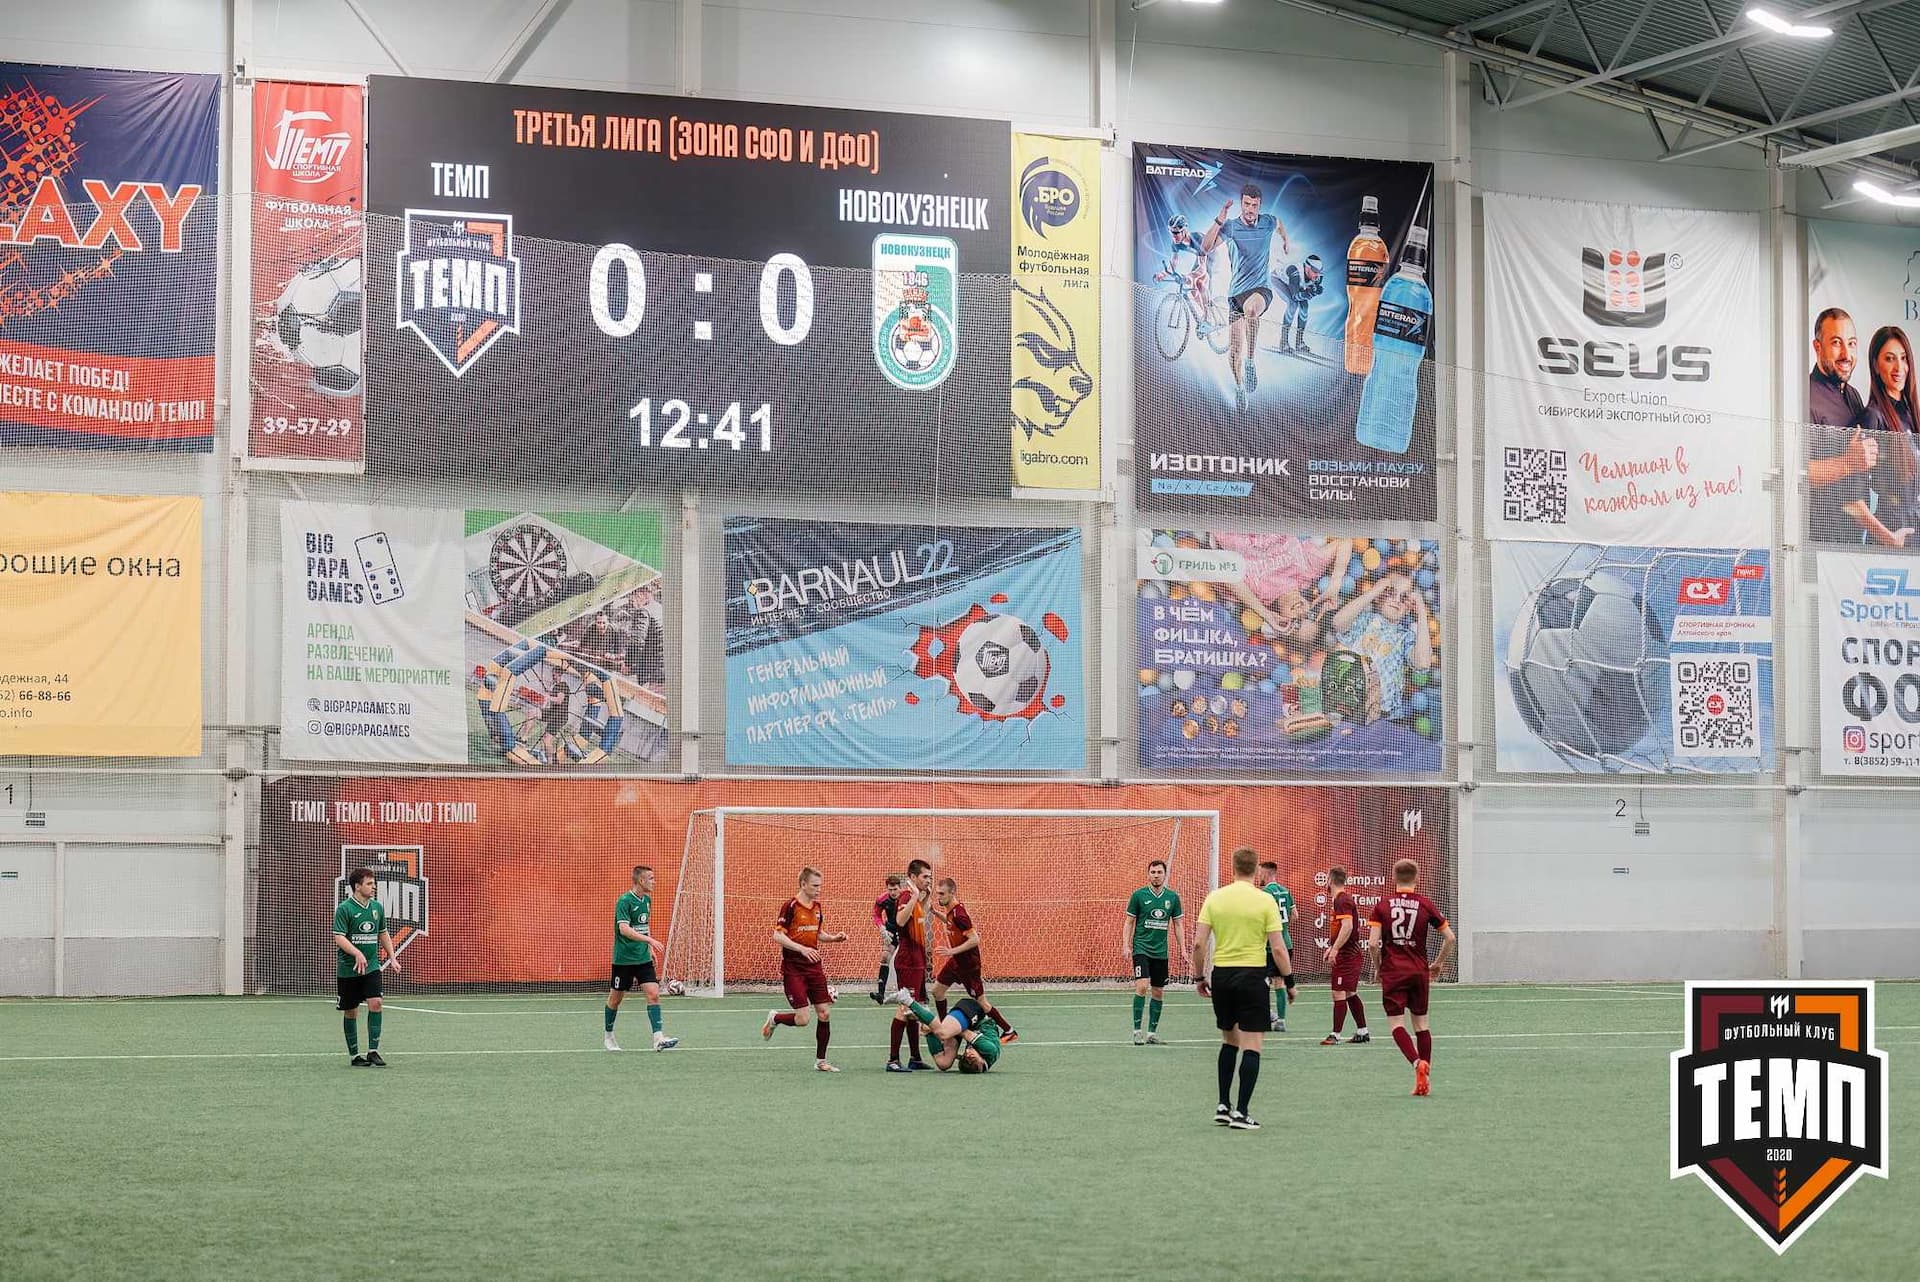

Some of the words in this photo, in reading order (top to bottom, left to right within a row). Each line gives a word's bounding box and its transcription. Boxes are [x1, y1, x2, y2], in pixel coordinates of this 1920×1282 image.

[513, 110, 596, 149] ТРЕТЬЯ
[602, 116, 662, 153] ЛИГА
[669, 116, 738, 161] (ЗОНА
[745, 127, 793, 163] СФО
[799, 130, 814, 163] И
[820, 130, 880, 175] ДФО)
[292, 163, 342, 172] СПОРТИВНАЯ
[1145, 164, 1213, 178] BATTERADE
[431, 162, 489, 199] ТЕМП
[0, 176, 202, 252] AXY
[265, 201, 352, 216] ФУТБОЛЬНАЯ
[839, 188, 990, 231] НОВОКУЗНЕЦК
[286, 217, 330, 229] ШКОЛА
[881, 243, 951, 260] НОВОКУЗНЕЦК
[1017, 246, 1090, 261] Молодёжная
[1019, 260, 1090, 275] футбольная
[409, 257, 507, 316] ТЕМП
[589, 242, 646, 338] 0
[759, 252, 814, 346] 0
[1063, 279, 1090, 288] лига
[1537, 336, 1713, 383] SEUS
[69, 364, 130, 393] ПОБЕД!
[0, 383, 43, 410] ЕСТЕ
[47, 391, 57, 412] С
[62, 398, 154, 424] КОМАНДОЙ
[158, 399, 206, 422] ТЕМП!
[1582, 387, 1627, 406] Export
[1629, 391, 1668, 407] Union
[629, 397, 771, 452] 12:41
[1537, 403, 1603, 420] СИБИРСКИЙ
[1606, 408, 1681, 425] ЭКСПОРТНЫЙ
[1682, 412, 1712, 425] СОЮЗ
[263, 416, 352, 436] 39-57-29
[1150, 452, 1291, 476] ИЗОТОНИК
[1309, 459, 1372, 473] ВОЗЬМИ
[1578, 450, 1674, 484] Чемпион
[1309, 474, 1411, 488] ВОССТАНОВИ
[1584, 480, 1673, 515] каждом
[1674, 483, 1701, 509] из
[1702, 464, 1745, 498] нас!
[1309, 488, 1358, 501] СИЛЫ.
[305, 532, 334, 555] BIG
[106, 555, 182, 578] окна
[306, 556, 350, 579] PAPA
[1178, 560, 1216, 570] ГРИЛЬ
[307, 580, 365, 604] GAMES
[816, 589, 892, 613] СООБЩЕСТВО
[1154, 606, 1166, 621] В
[1169, 600, 1214, 622] ЧЁМ
[306, 622, 355, 642] АРЕНДА
[1154, 628, 1238, 648] ФИШКА,
[306, 643, 395, 663] РАЗВЛЕЧЕНИЙ
[1154, 649, 1268, 667] БРАТИШКА?
[306, 664, 324, 681] НА
[326, 665, 363, 682] ВАШЕ
[365, 667, 452, 686] МЕРОПРИЯТИЕ
[746, 645, 850, 684] ГЕНЕРАЛЬНЫЙ
[54, 673, 70, 685] 44
[18, 690, 72, 702] 66-88-66
[747, 665, 888, 716] ИНФОРМАЦИОННЫЙ
[323, 699, 412, 716] BIGPAPAGAMES.RU
[324, 721, 411, 738] @BIGPAPAGAMES
[746, 713, 812, 744] ПАРТНЕР
[815, 708, 840, 730] ФК
[843, 697, 898, 722] «ТЕМП»
[5, 784, 13, 804] 1
[290, 800, 329, 825] ТЕМП,
[335, 801, 374, 825] ТЕМП,
[379, 801, 432, 823] ТОЛЬКО
[437, 802, 477, 824] ТЕМП!
[1615, 798, 1626, 817] 2
[1391, 908, 1418, 939] 27
[1135, 966, 1142, 977] 8
